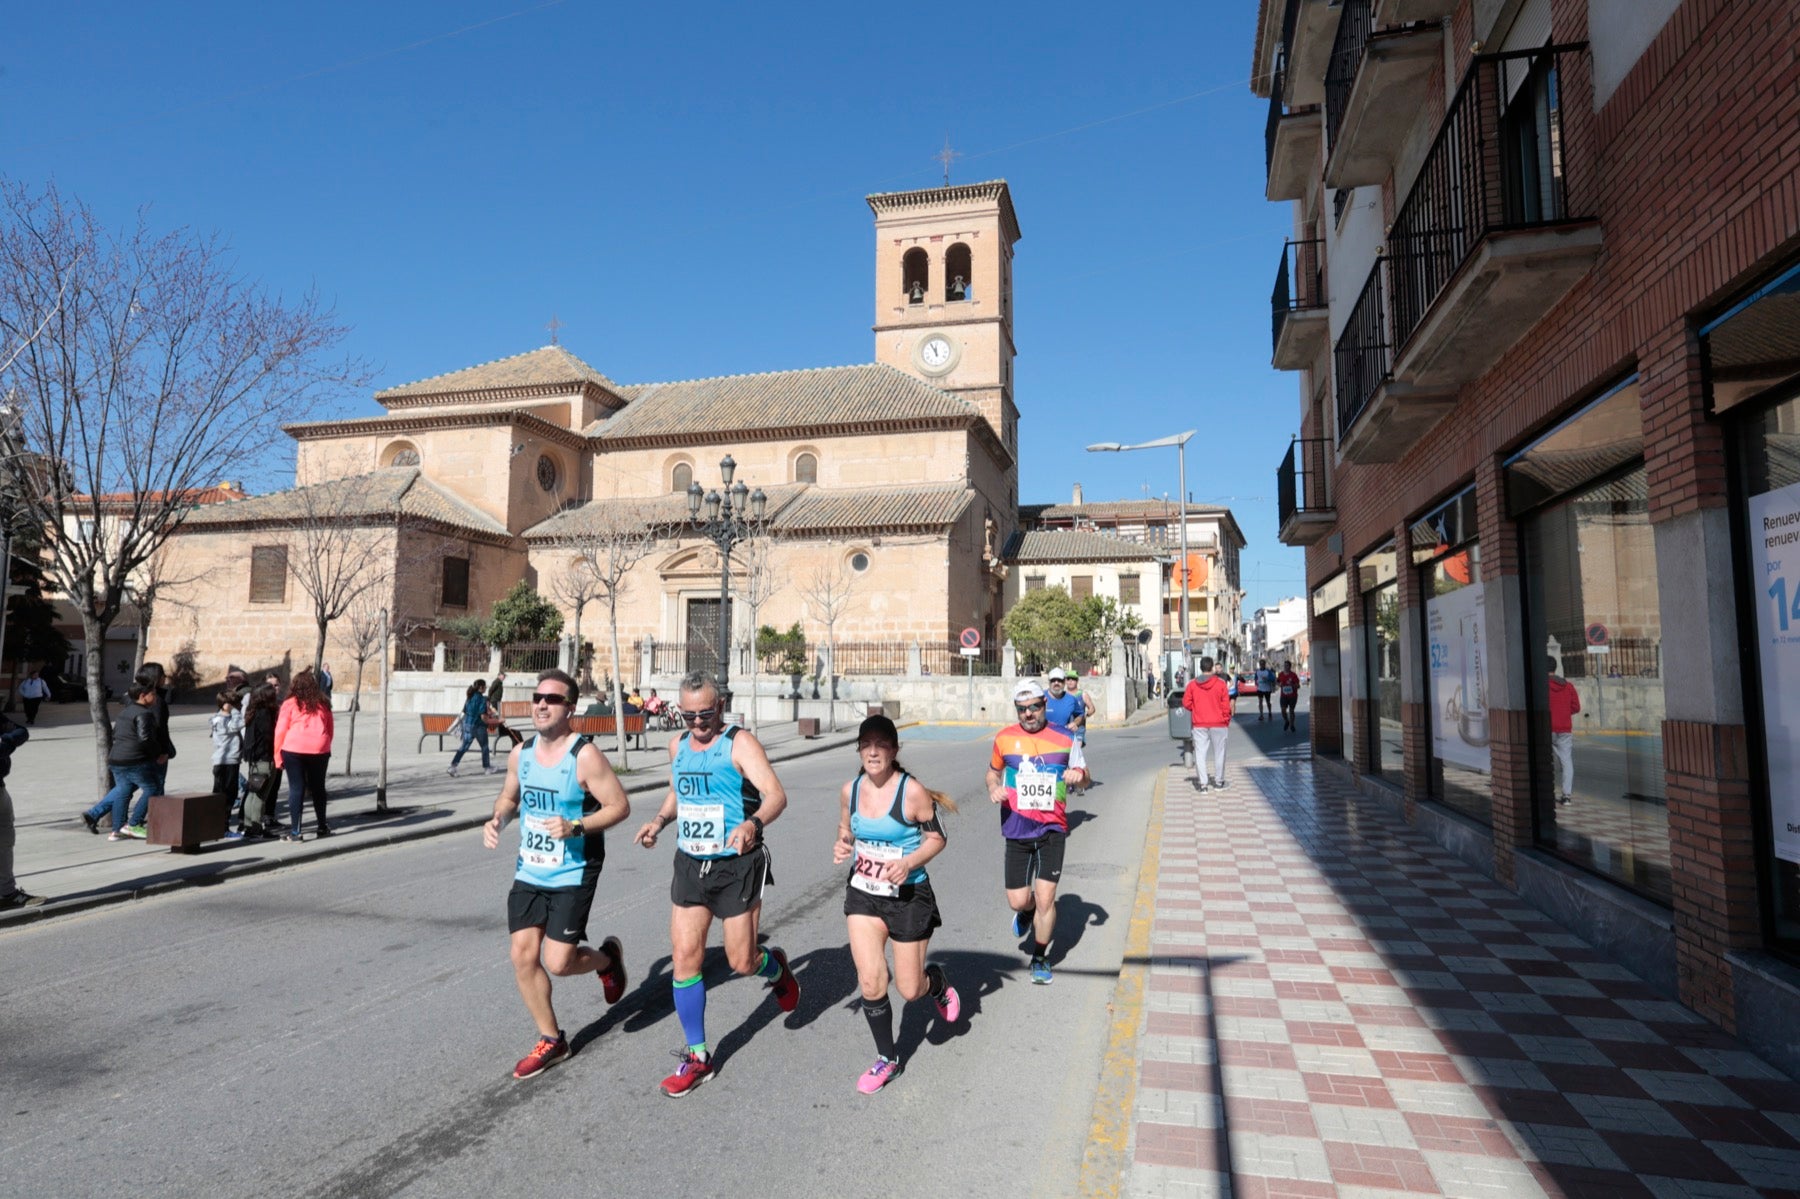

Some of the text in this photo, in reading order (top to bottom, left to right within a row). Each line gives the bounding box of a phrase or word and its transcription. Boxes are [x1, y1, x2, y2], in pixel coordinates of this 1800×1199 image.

[1765, 531, 1800, 549] renuev
[1766, 560, 1781, 575] por
[1021, 784, 1052, 797] 3054
[683, 820, 714, 839] 822
[526, 831, 555, 852] 825
